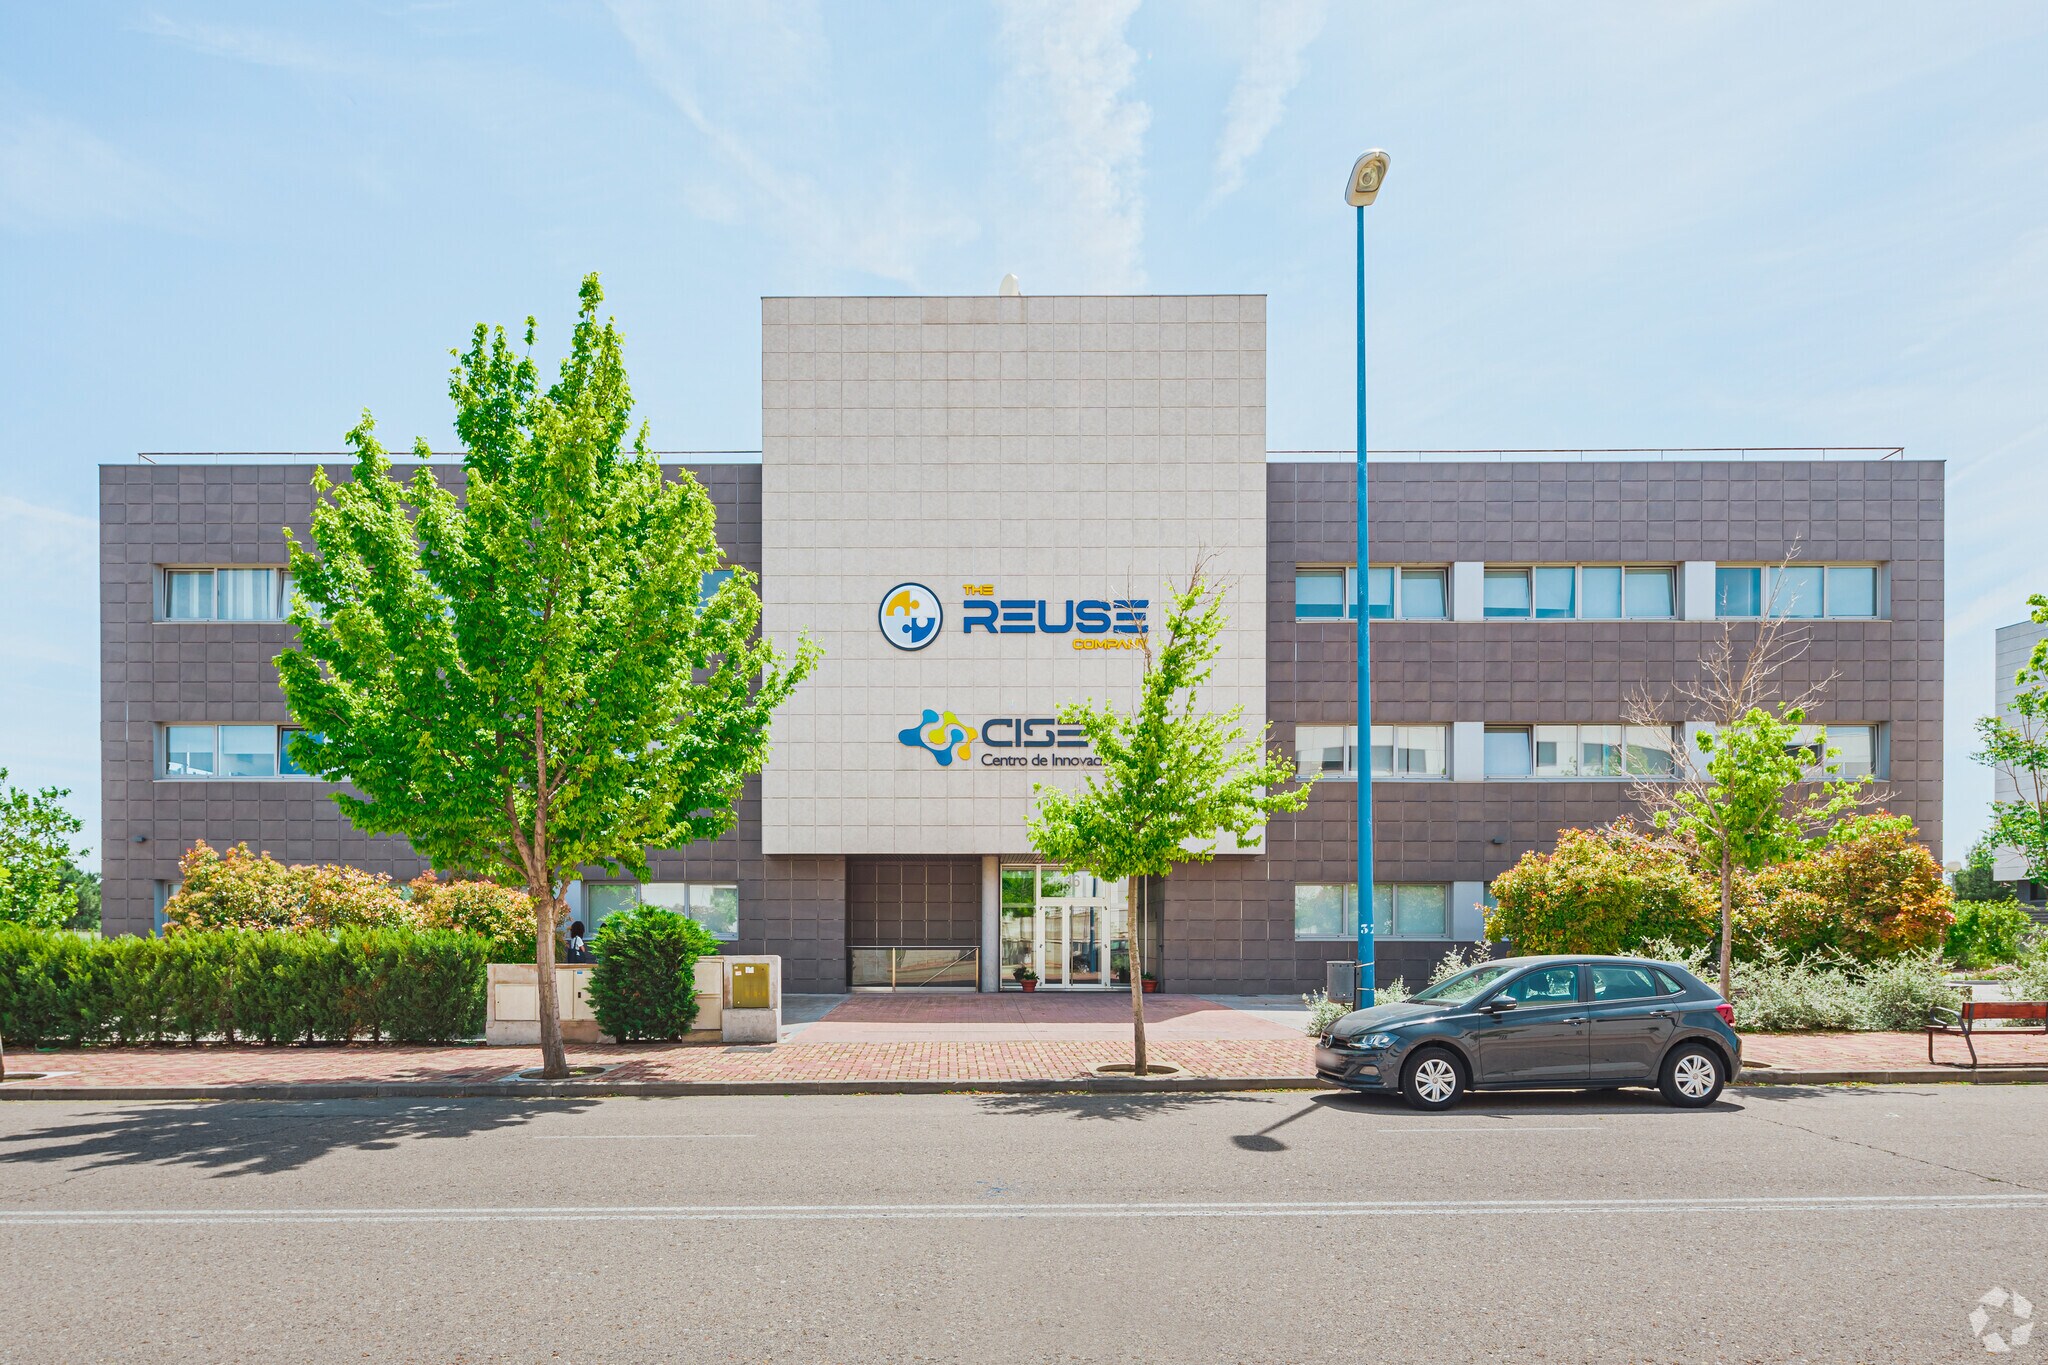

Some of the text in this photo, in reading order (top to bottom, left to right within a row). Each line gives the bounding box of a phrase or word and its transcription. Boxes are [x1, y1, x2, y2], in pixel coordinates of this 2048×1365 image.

[963, 584, 994, 596] THE
[963, 599, 1149, 633] REUSE
[1072, 638, 1149, 650] COMPANY
[981, 753, 1028, 766] Centro
[1031, 753, 1048, 766] de
